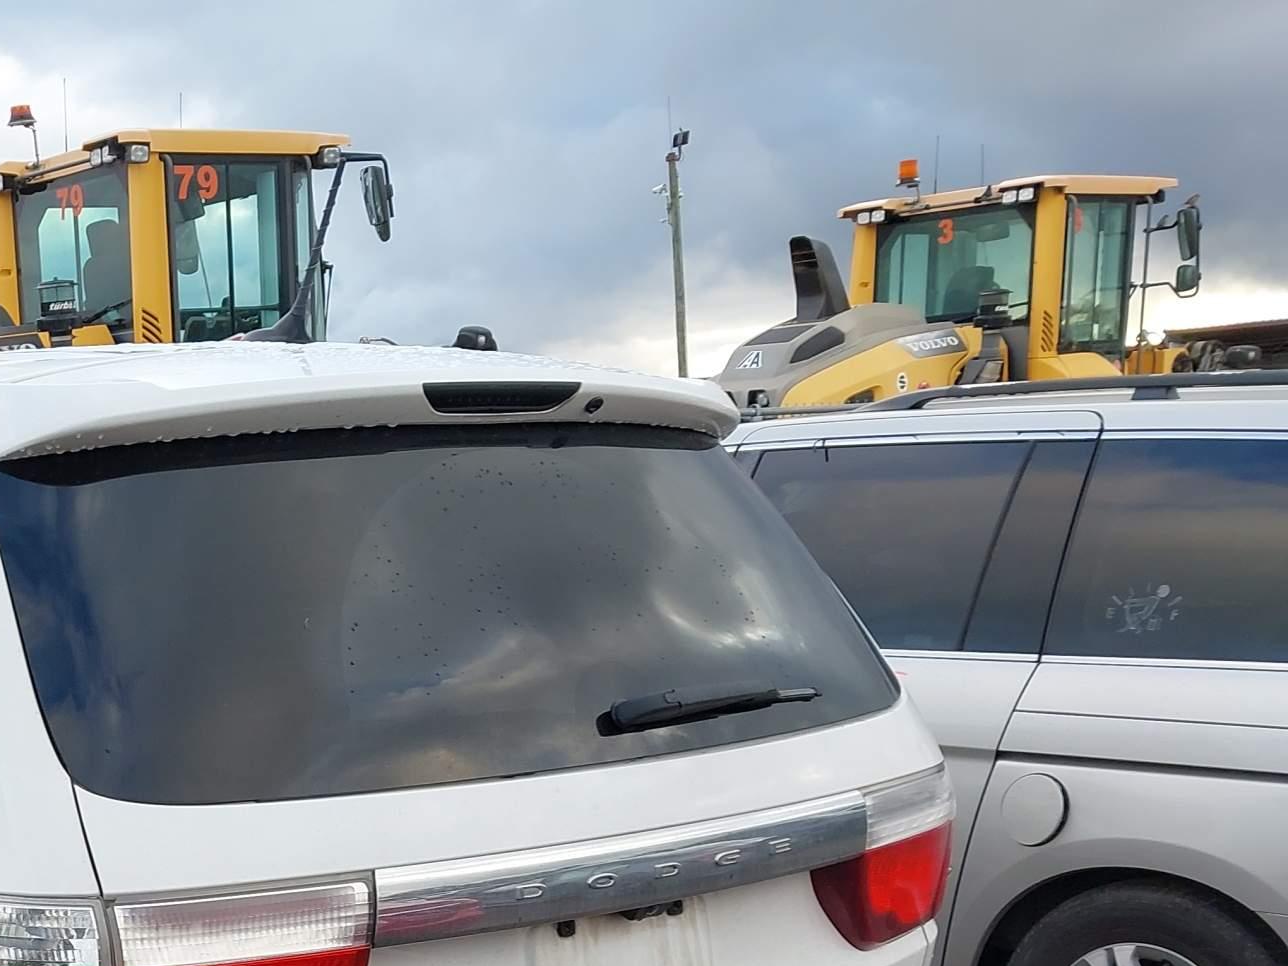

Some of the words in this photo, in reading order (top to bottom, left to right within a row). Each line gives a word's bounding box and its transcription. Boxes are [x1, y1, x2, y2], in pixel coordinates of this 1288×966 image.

[173, 164, 219, 200] 79
[56, 183, 84, 220] 79
[937, 218, 954, 245] 3
[907, 336, 959, 352] VOLVO
[516, 839, 791, 900] DODGE
